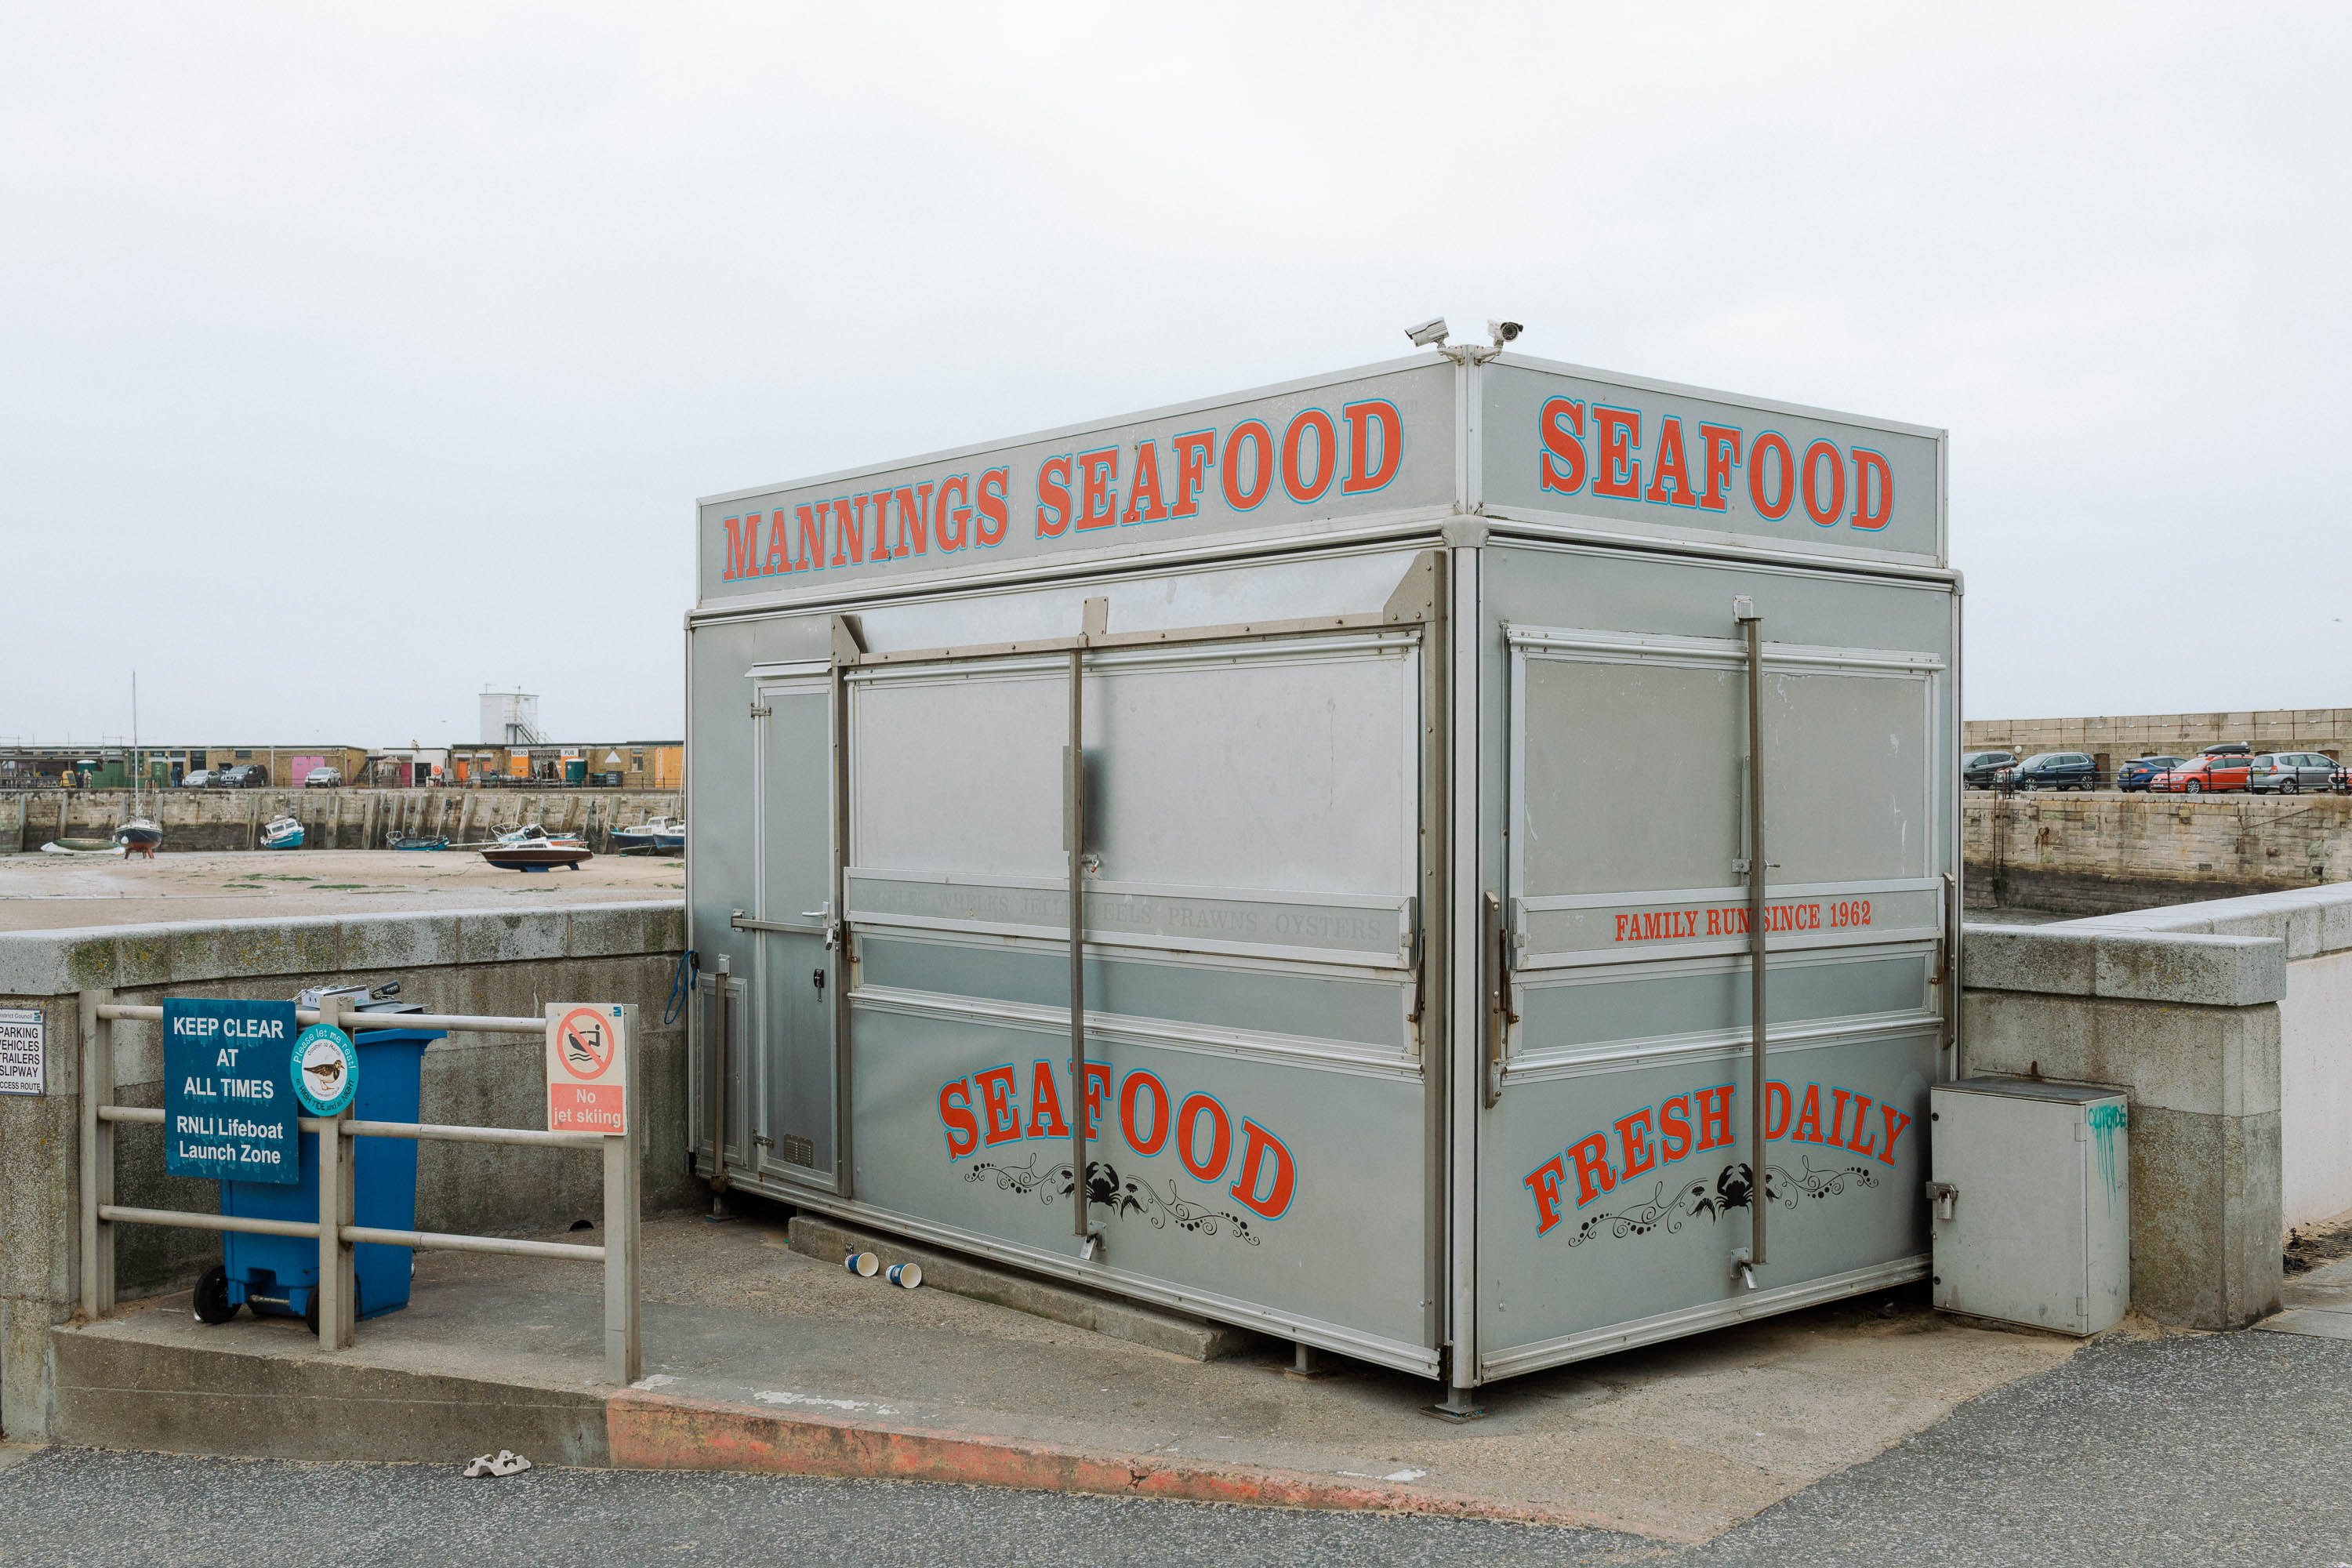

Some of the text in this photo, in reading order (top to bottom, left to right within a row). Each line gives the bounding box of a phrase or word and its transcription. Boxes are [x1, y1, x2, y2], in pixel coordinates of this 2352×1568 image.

[1538, 395, 1895, 532] SEAFOOD
[721, 397, 1404, 583] MANNINGS SEAFOOD
[1103, 902, 1153, 924] EELS
[1167, 907, 1258, 931] PRAWNS
[1275, 913, 1381, 942] OYSTERS
[1615, 901, 1871, 942] FAMILY RUN SINCE 1962
[173, 1017, 284, 1039] KEEP CLEAR
[216, 1048, 238, 1067] AT
[293, 1033, 314, 1063] Please
[316, 1029, 328, 1038] let
[330, 1032, 342, 1044] me
[183, 1076, 274, 1099] ALL TIMES
[300, 1085, 312, 1104] HIGH
[312, 1099, 325, 1111] TIDE
[341, 1078, 354, 1102] NIGHT
[576, 1088, 597, 1104] No
[176, 1116, 283, 1139] RNLI Lifeboat
[554, 1107, 621, 1128] jet skiing
[180, 1140, 281, 1164] Launch Zone
[938, 1058, 1298, 1221] SEAFOOD
[1523, 1079, 1914, 1238] FRESH DAILY
